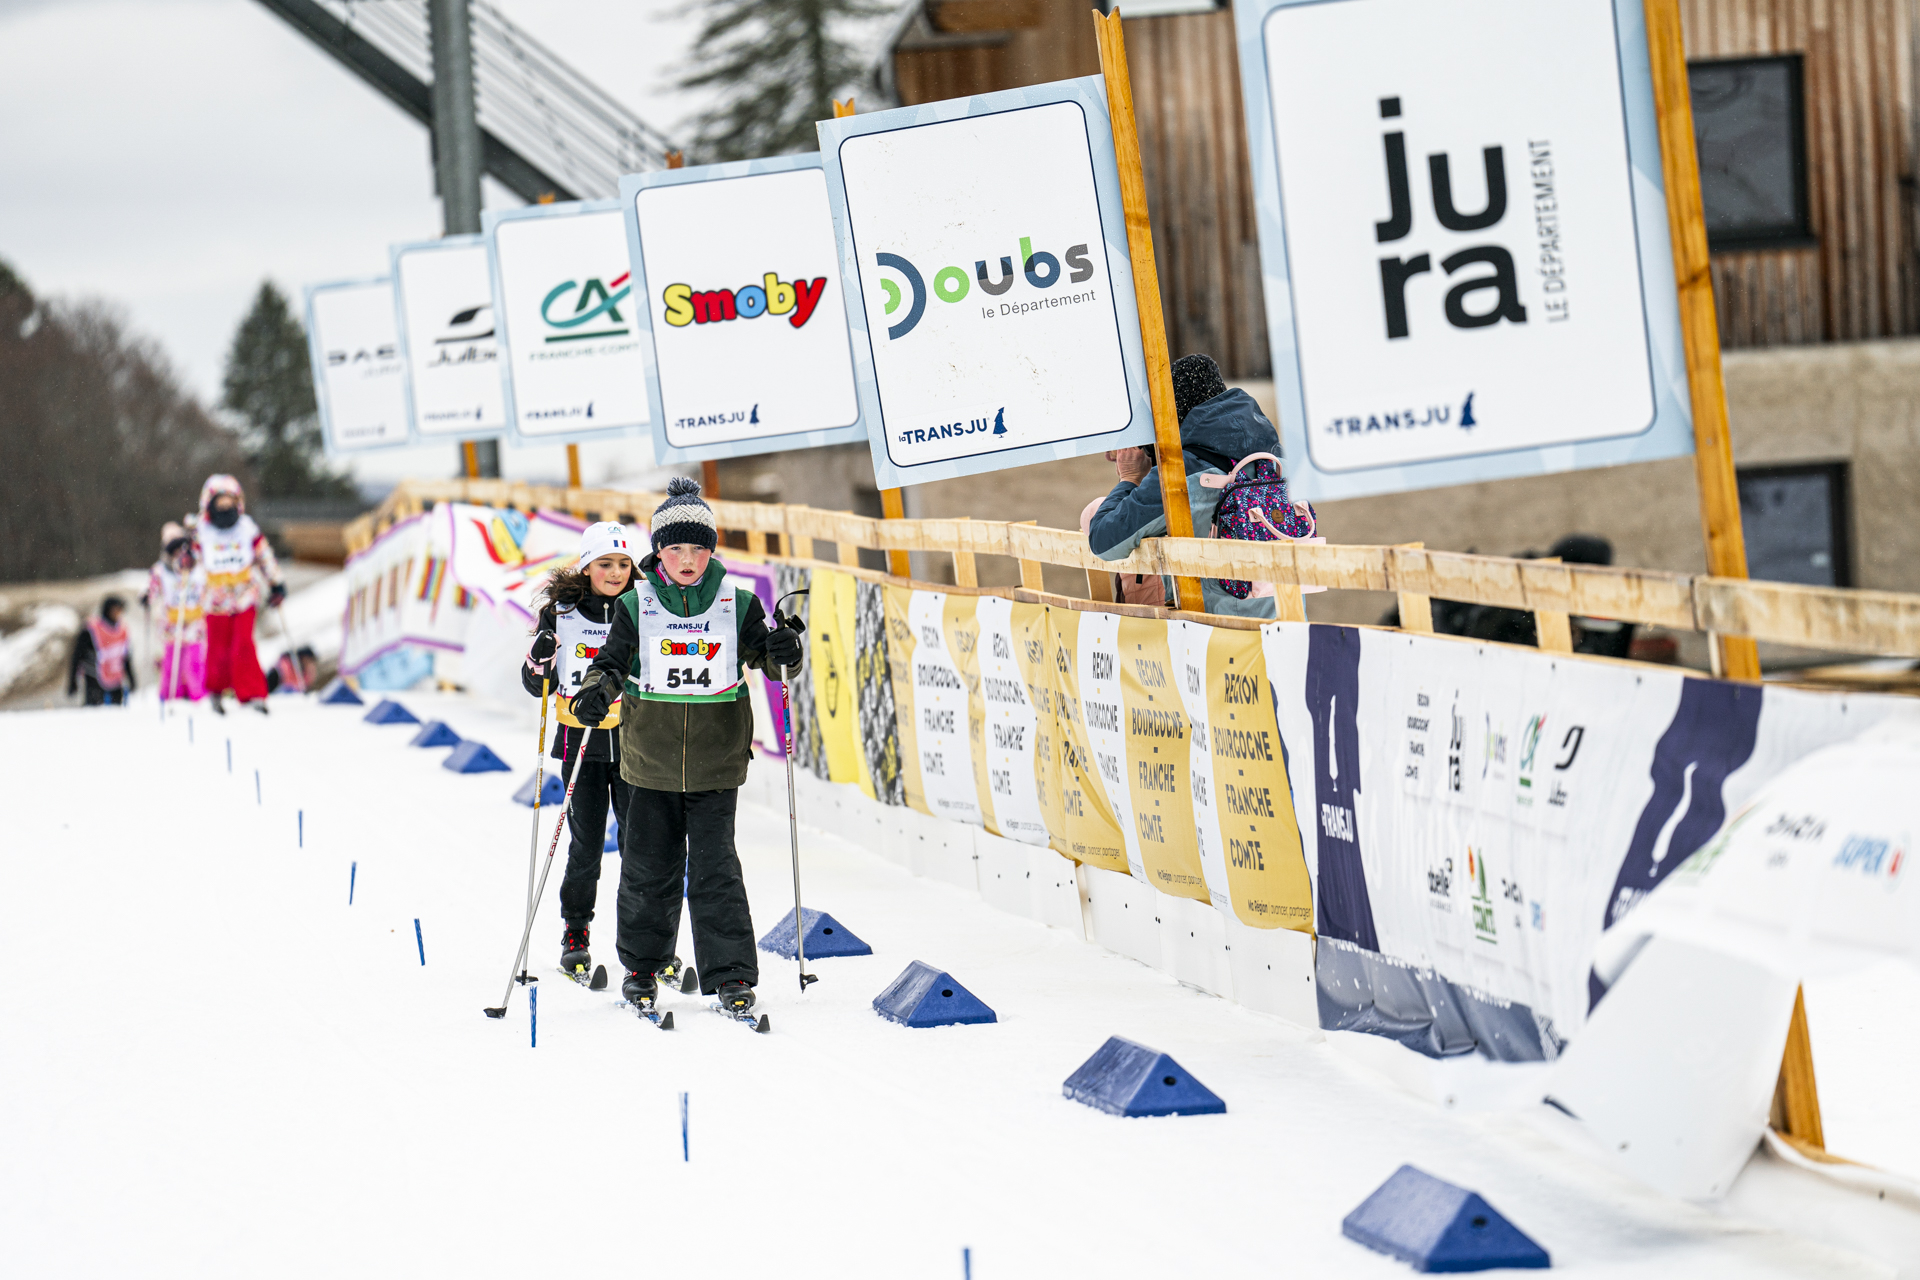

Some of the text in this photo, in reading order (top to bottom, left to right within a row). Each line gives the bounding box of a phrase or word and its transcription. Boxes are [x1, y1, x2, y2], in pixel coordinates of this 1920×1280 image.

[1375, 95, 1508, 242] ju
[1528, 139, 1569, 323] LE DÉPARTEMENT
[663, 272, 827, 329] Smoby
[876, 236, 1094, 340] Doubs
[981, 290, 1096, 319] le Département
[1378, 244, 1528, 340] ra
[679, 411, 745, 429] TRANSJU
[660, 638, 722, 662] Smoby
[667, 667, 711, 688] 514
[1131, 707, 1184, 739] BOURGOGNE
[1213, 725, 1274, 762] BOURGOGNE
[1138, 760, 1176, 793] FRANCHE
[1225, 783, 1275, 818] FRANCHE
